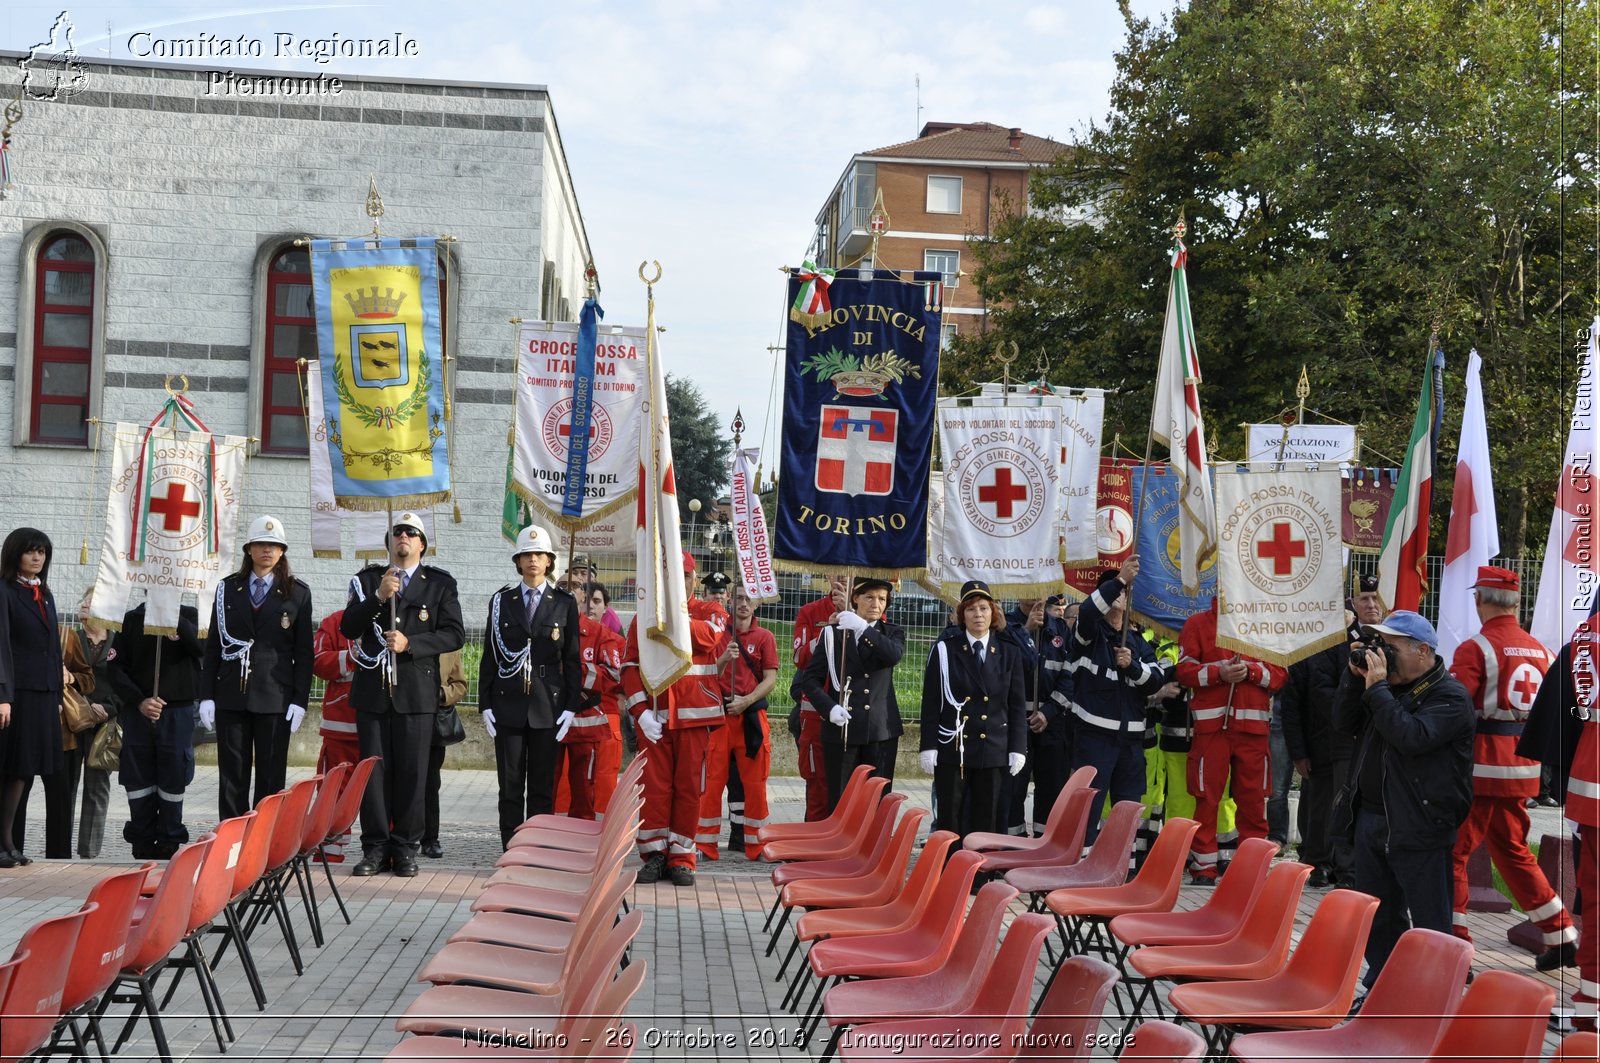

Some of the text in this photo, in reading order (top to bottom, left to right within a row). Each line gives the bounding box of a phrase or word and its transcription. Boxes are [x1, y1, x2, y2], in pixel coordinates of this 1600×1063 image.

[853, 331, 874, 346] DI
[596, 344, 637, 361] OSSA
[527, 376, 557, 388] COMITATO
[603, 382, 610, 391] DI
[612, 383, 636, 393] TORINO
[944, 419, 1056, 430] CORPO VOLONTARI DEL SOCCORSO
[566, 376, 589, 507] VOLONTARI DEL SOCCORSO
[1263, 438, 1341, 449] ASSOCIAZIONE
[946, 432, 1059, 485] CROCE ROSSA ITALIANA
[599, 473, 620, 484] DEL
[544, 484, 606, 498] SOCRSO
[962, 450, 1044, 533] CONVENZIONE DI GINEVRA 22 AGOSTO 1864
[1148, 500, 1178, 524] GRUPP
[1221, 485, 1338, 541] CROCE ROSSA ITALIANA
[1251, 514, 1264, 526] DI
[1265, 505, 1307, 524] GINEVRA
[592, 525, 616, 533] LOCALE
[734, 471, 756, 584] CROCE ROSSA ITALIANA
[797, 506, 907, 536] TORINO
[1305, 522, 1317, 536] 22
[753, 506, 772, 583] BORGOSESIA
[949, 555, 1035, 570] CASTAGNOLE
[1240, 526, 1274, 591] CONVENZIONE
[1308, 537, 1322, 574] AGOSTO
[162, 565, 173, 576] DI
[176, 558, 219, 571] LOCALE
[1226, 600, 1337, 614] COMITATO LOCALE
[1238, 620, 1325, 636] CARIGNANO
